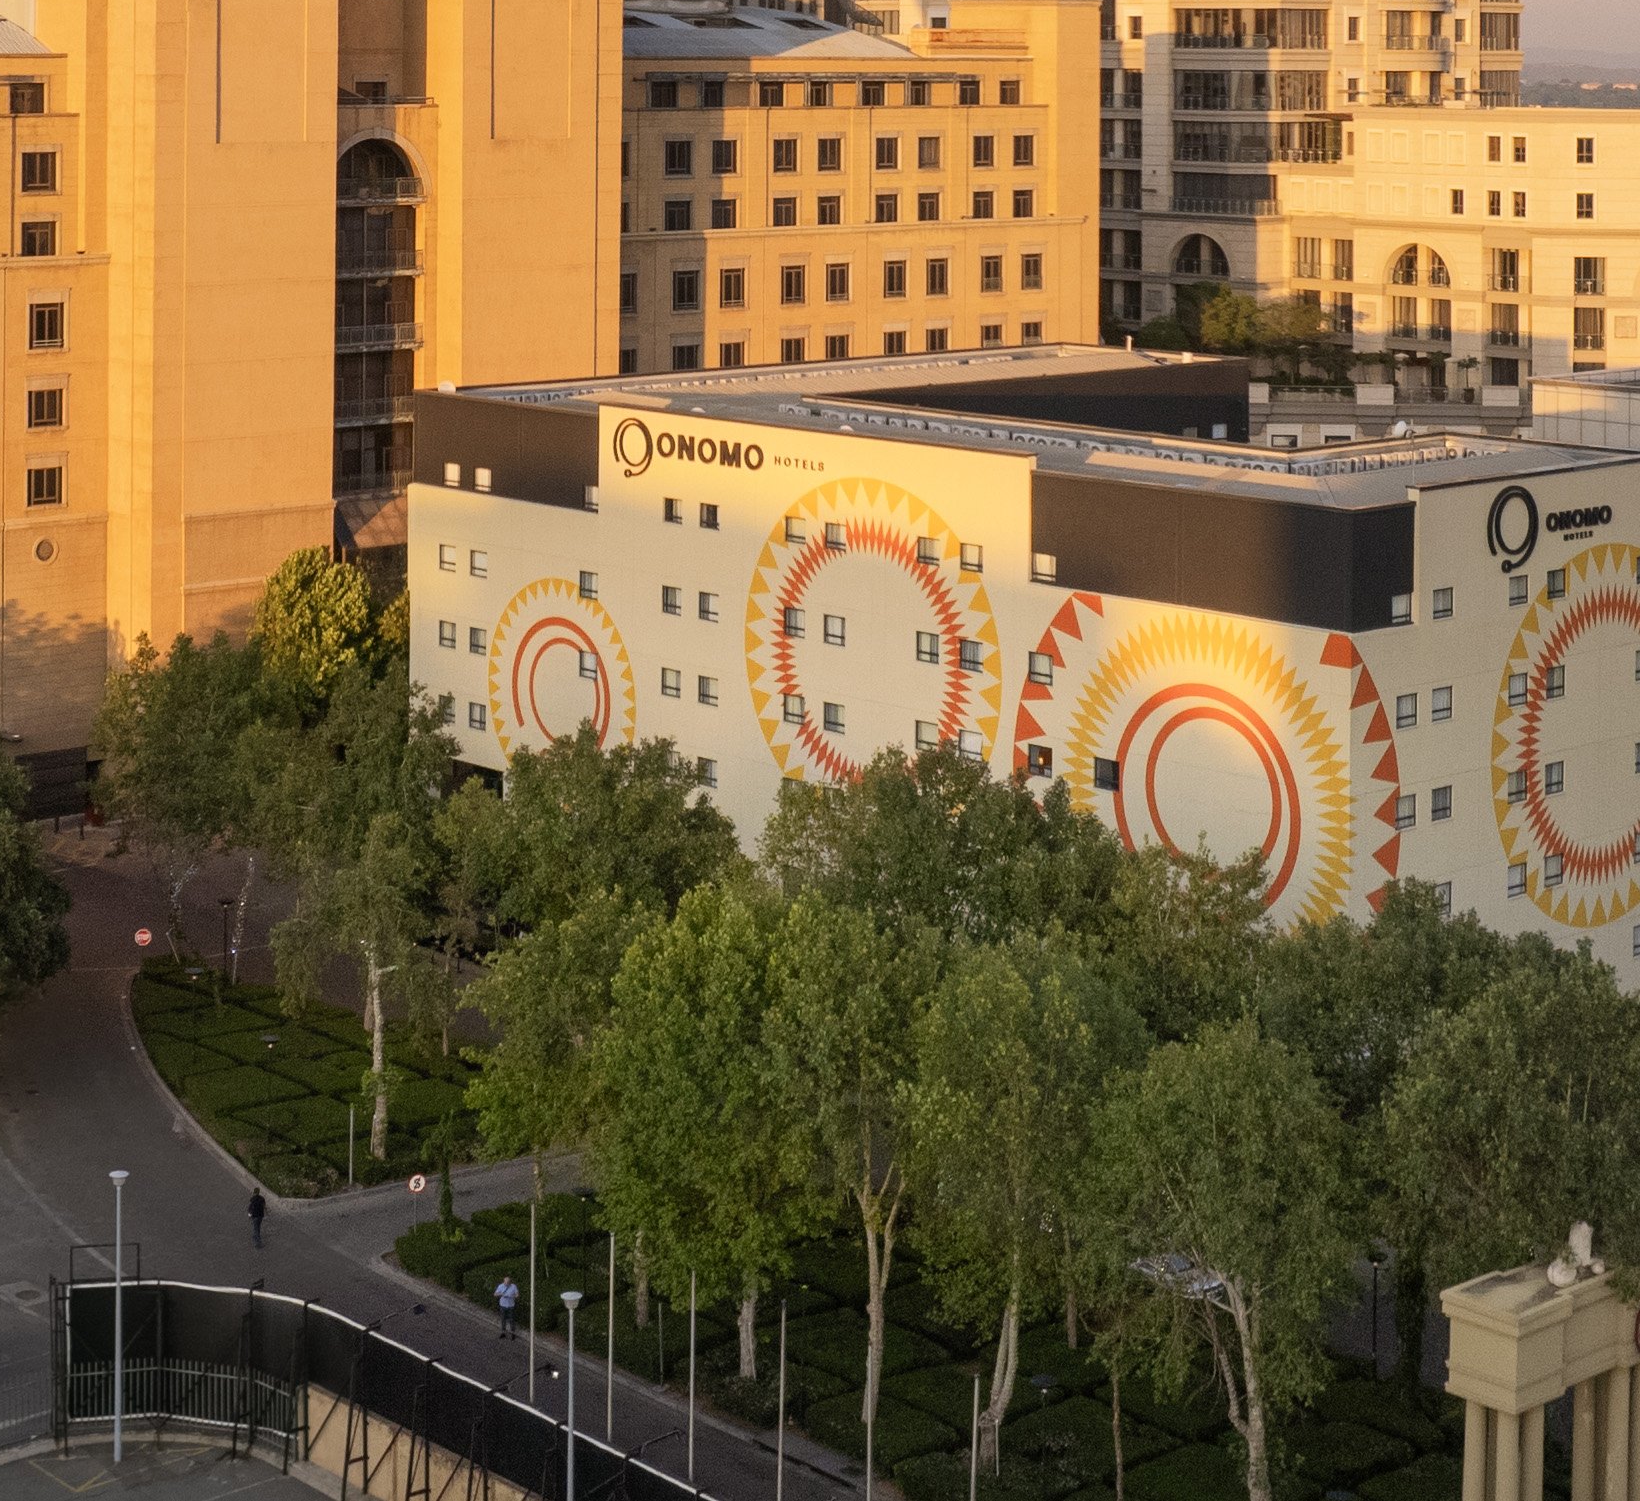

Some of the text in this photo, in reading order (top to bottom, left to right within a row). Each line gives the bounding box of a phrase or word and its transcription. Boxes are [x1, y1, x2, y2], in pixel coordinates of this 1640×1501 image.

[656, 432, 825, 472] ONOMO HOTELS
[1546, 504, 1613, 532] ONOMO
[1563, 530, 1594, 542] HOTELS
